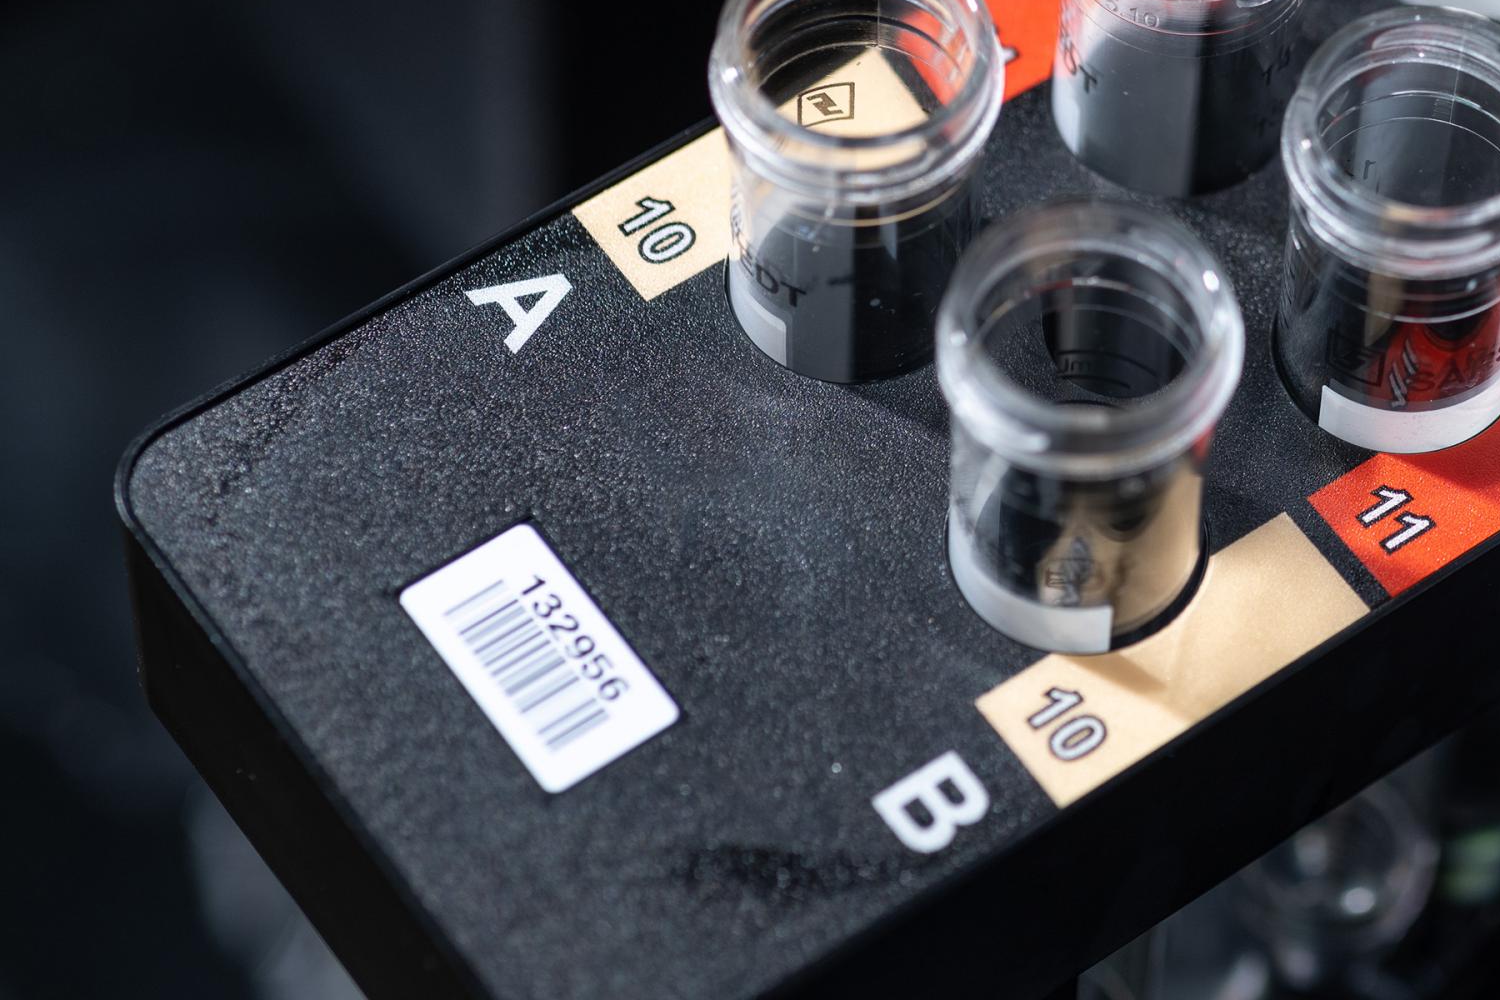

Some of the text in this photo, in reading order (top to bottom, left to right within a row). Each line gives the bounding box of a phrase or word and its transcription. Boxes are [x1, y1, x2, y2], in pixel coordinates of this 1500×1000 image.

[617, 196, 696, 264] 10
[463, 273, 573, 355] A
[1355, 484, 1438, 556] 11
[517, 572, 630, 704] 132956
[1027, 686, 1107, 763] 10
[871, 750, 992, 855] B
